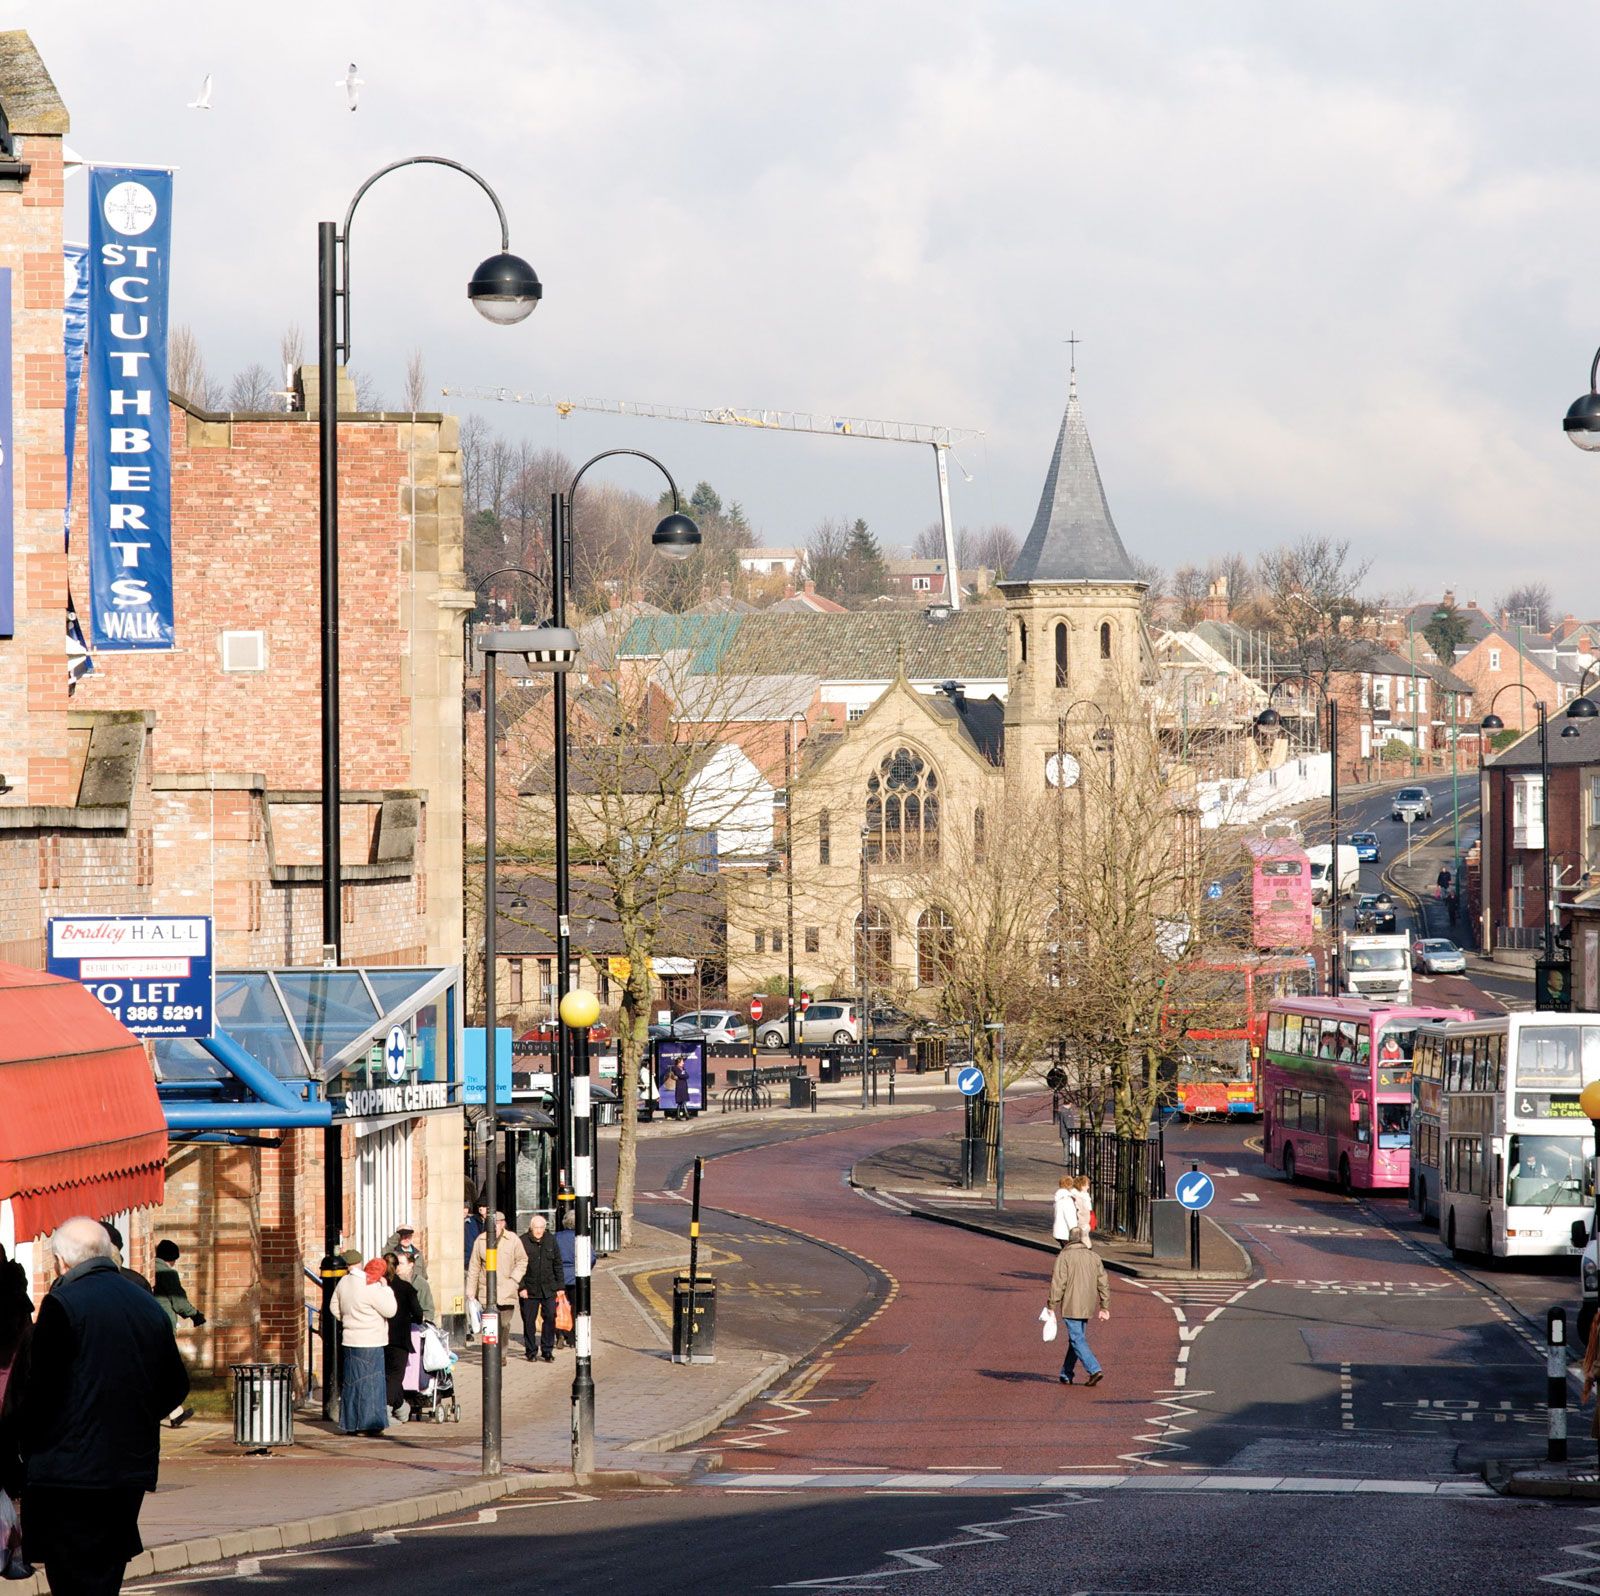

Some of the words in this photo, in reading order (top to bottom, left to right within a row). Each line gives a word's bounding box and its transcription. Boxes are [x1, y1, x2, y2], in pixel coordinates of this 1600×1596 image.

[102, 243, 157, 268] ST
[109, 276, 152, 606] CUTHBERTS
[103, 612, 160, 639] WALK
[61, 922, 126, 944] Bradley
[133, 983, 180, 1003] LET
[127, 1006, 158, 1021] 386
[163, 1006, 202, 1020] 5291
[345, 1086, 403, 1118] SHOPPING
[405, 1083, 447, 1111] CENTRE
[1542, 1108, 1558, 1117] via
